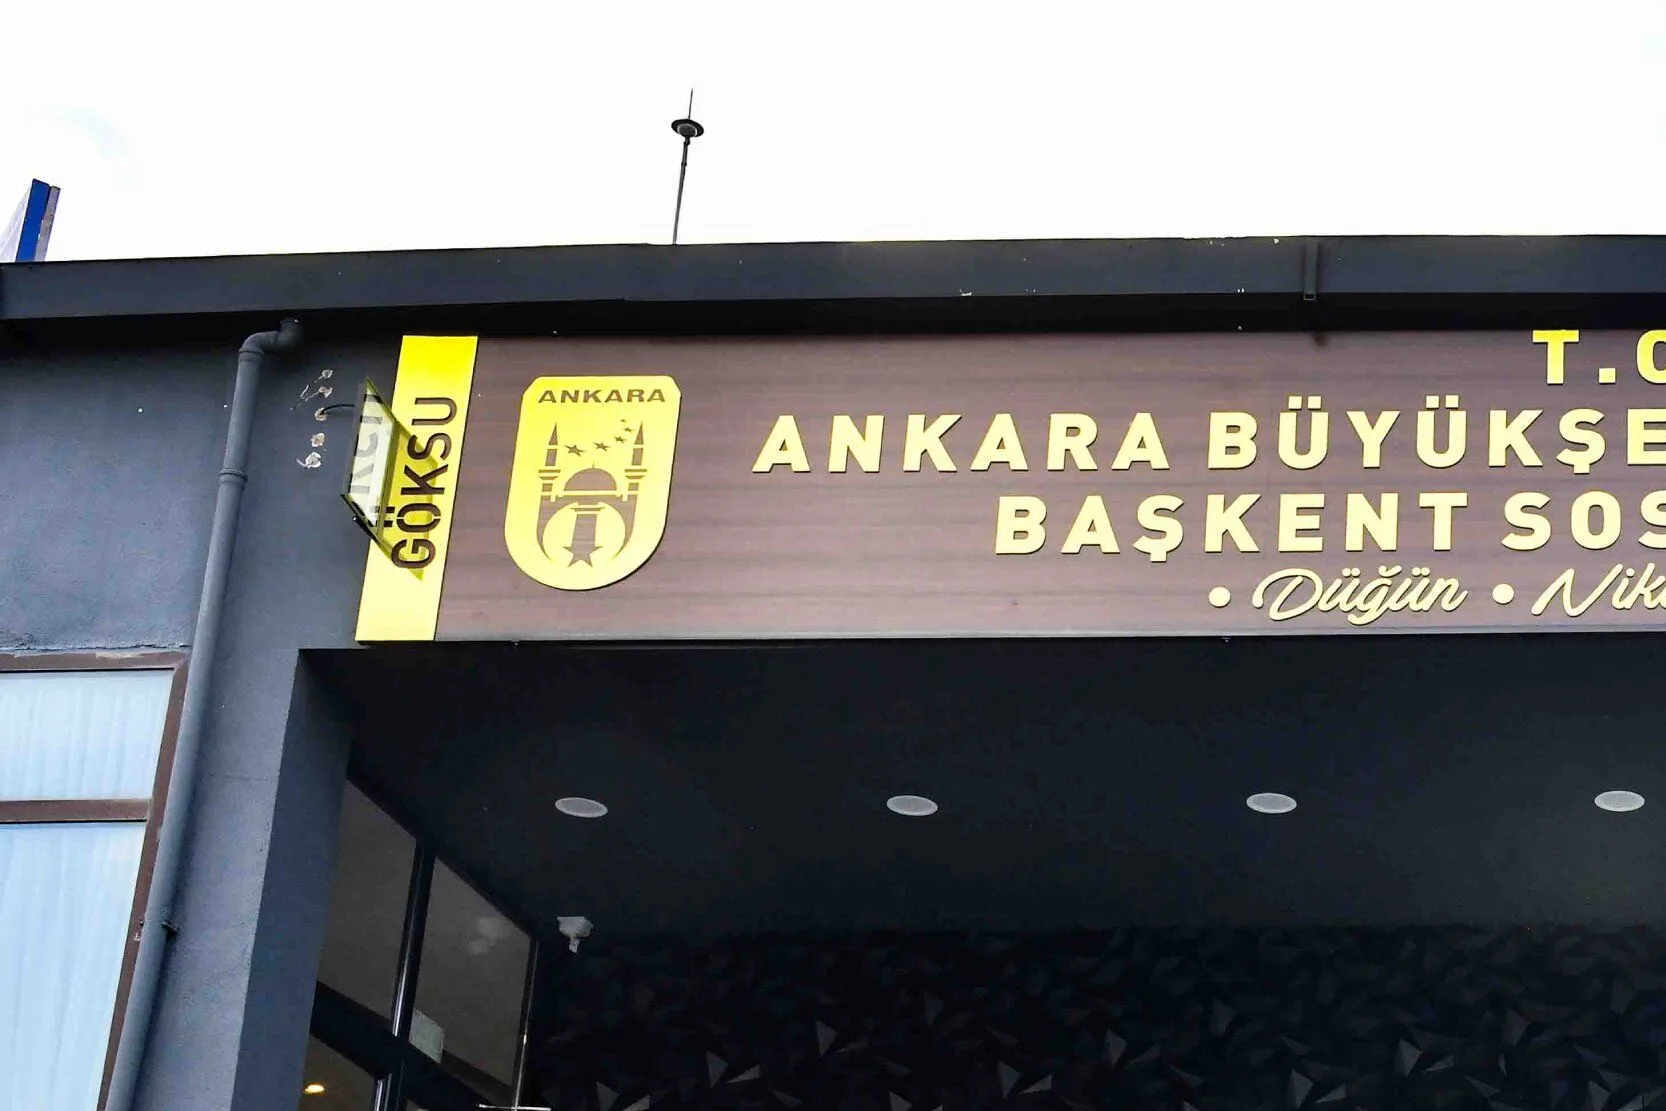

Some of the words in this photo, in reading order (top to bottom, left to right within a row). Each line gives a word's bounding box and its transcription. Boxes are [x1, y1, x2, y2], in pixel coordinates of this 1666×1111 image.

[538, 388, 666, 404] ANKARA
[752, 412, 1170, 473] ANKARA
[383, 397, 458, 569] GÖKSU
[995, 493, 1468, 562] BAŞKENT
[1252, 565, 1468, 625] Düğün
